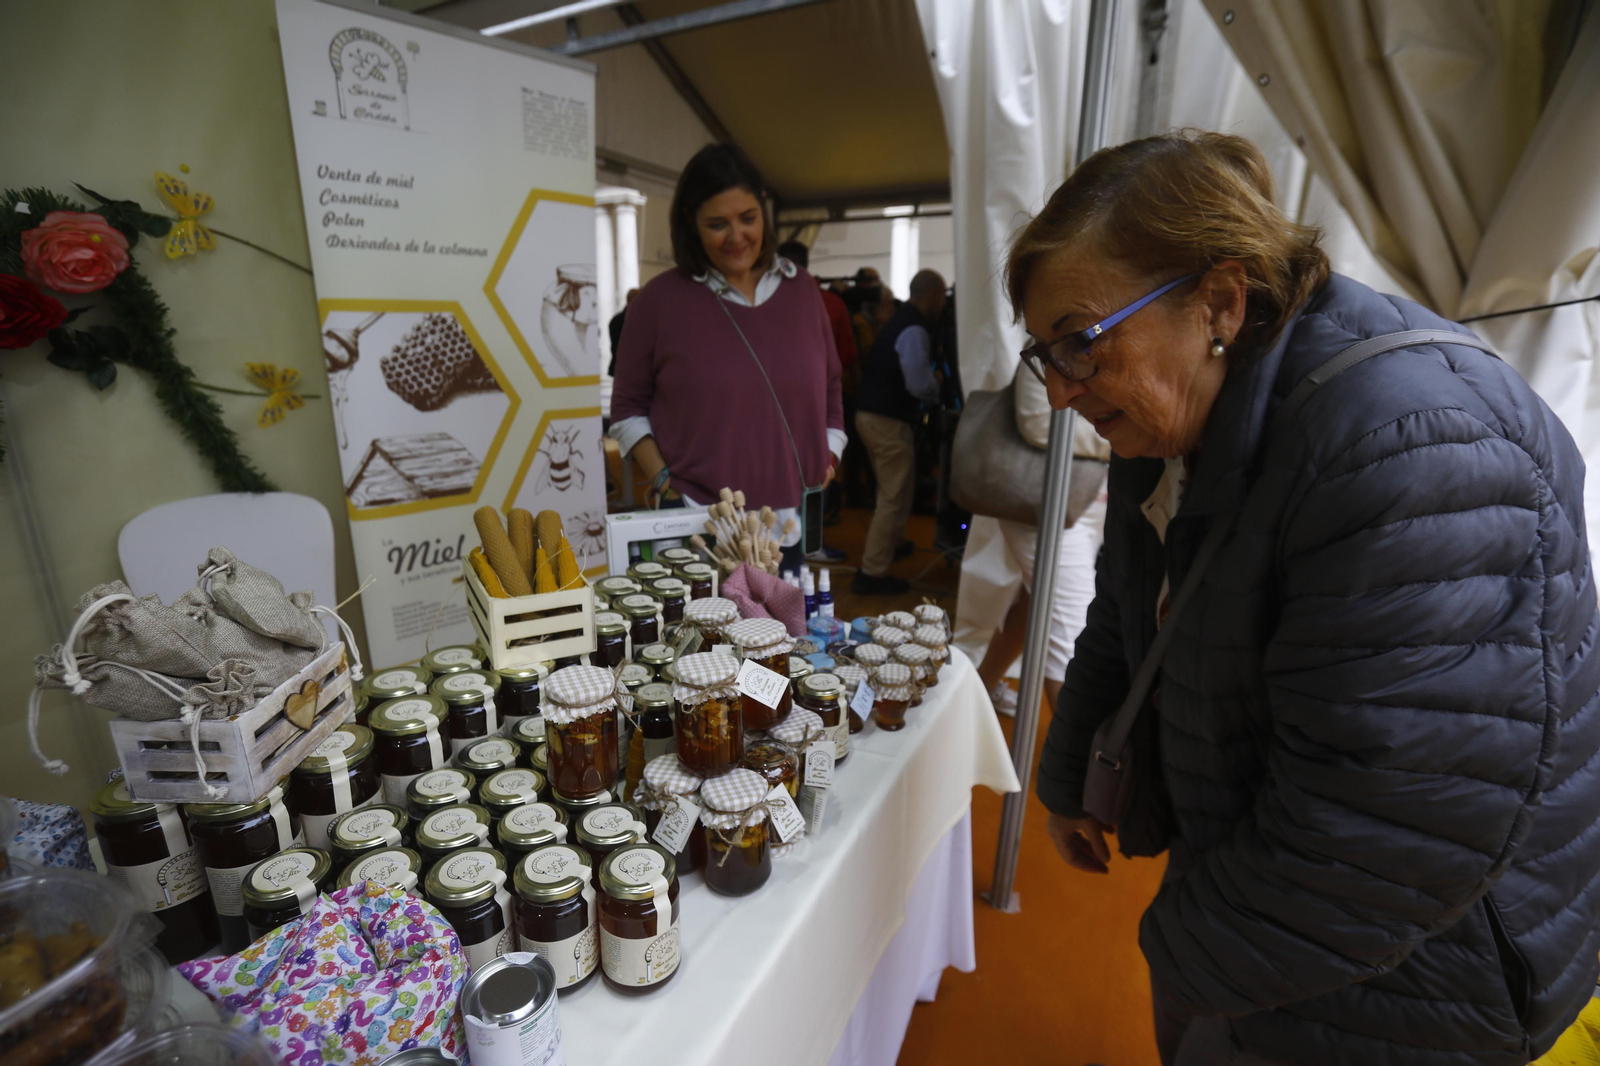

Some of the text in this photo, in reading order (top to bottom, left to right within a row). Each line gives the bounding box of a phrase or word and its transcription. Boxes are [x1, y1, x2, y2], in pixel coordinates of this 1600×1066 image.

[317, 164, 414, 189] Venta de miel
[319, 188, 400, 209] Cosméticos
[322, 210, 364, 228] Polen
[325, 234, 488, 257] Derivados de la colmena
[387, 534, 465, 575] Miel
